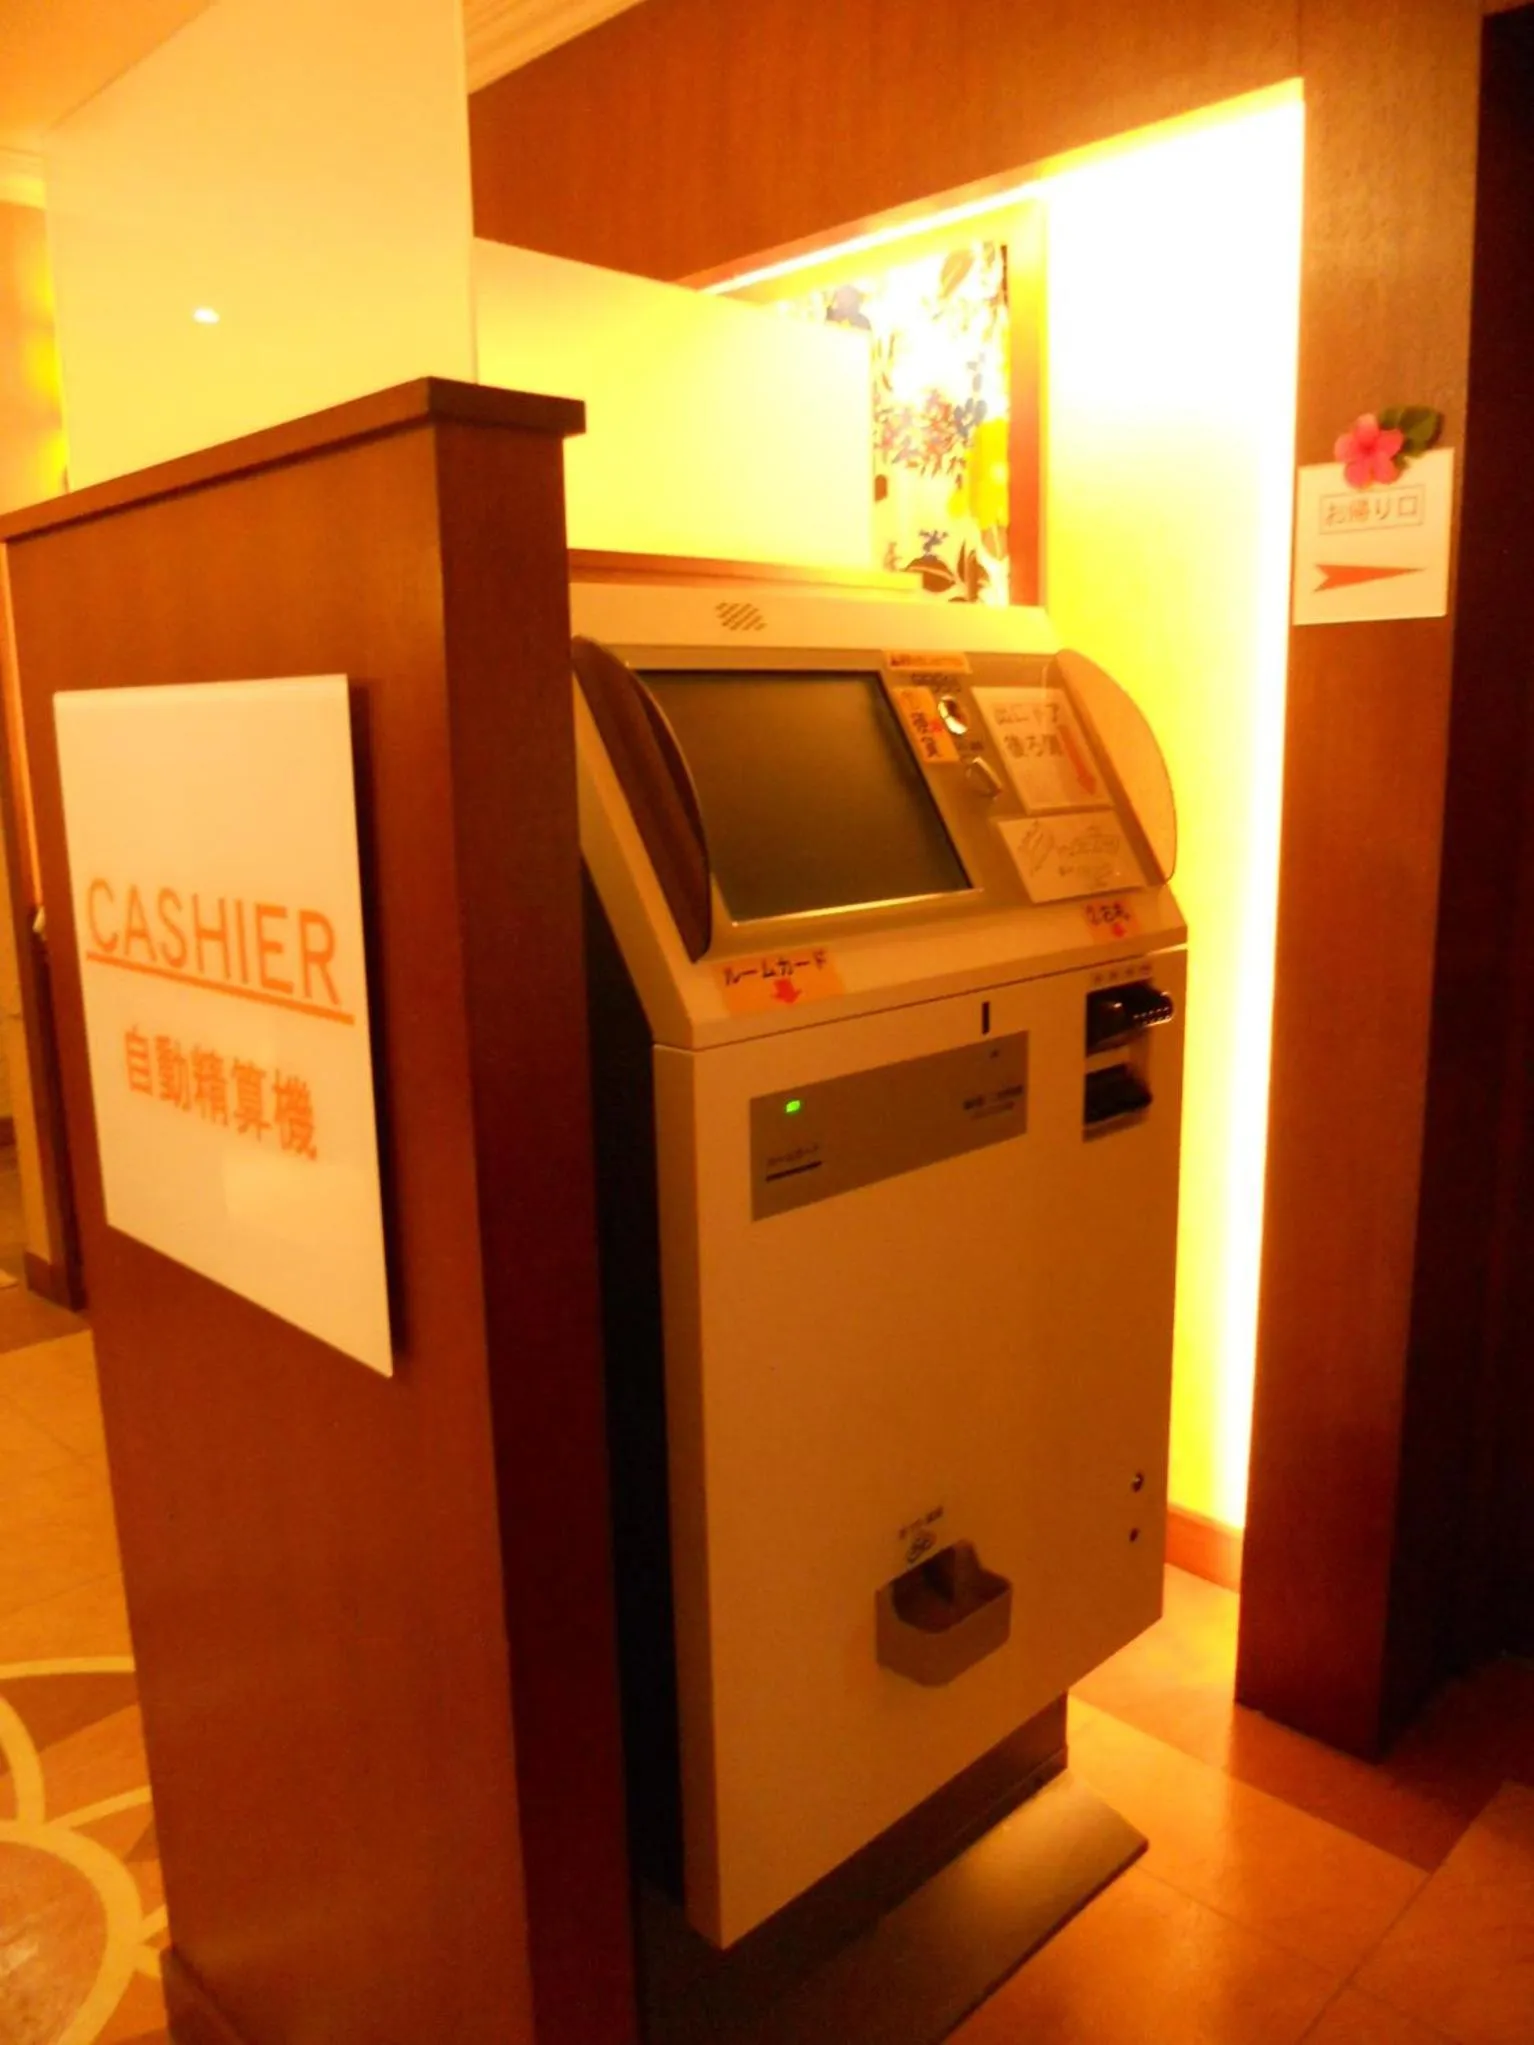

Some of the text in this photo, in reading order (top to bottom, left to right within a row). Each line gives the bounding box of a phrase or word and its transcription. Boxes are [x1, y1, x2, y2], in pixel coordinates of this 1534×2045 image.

[1326, 495, 1418, 526] お帰り口
[87, 877, 341, 1006] CASHIER
[124, 1024, 318, 1162] 自動精算機
